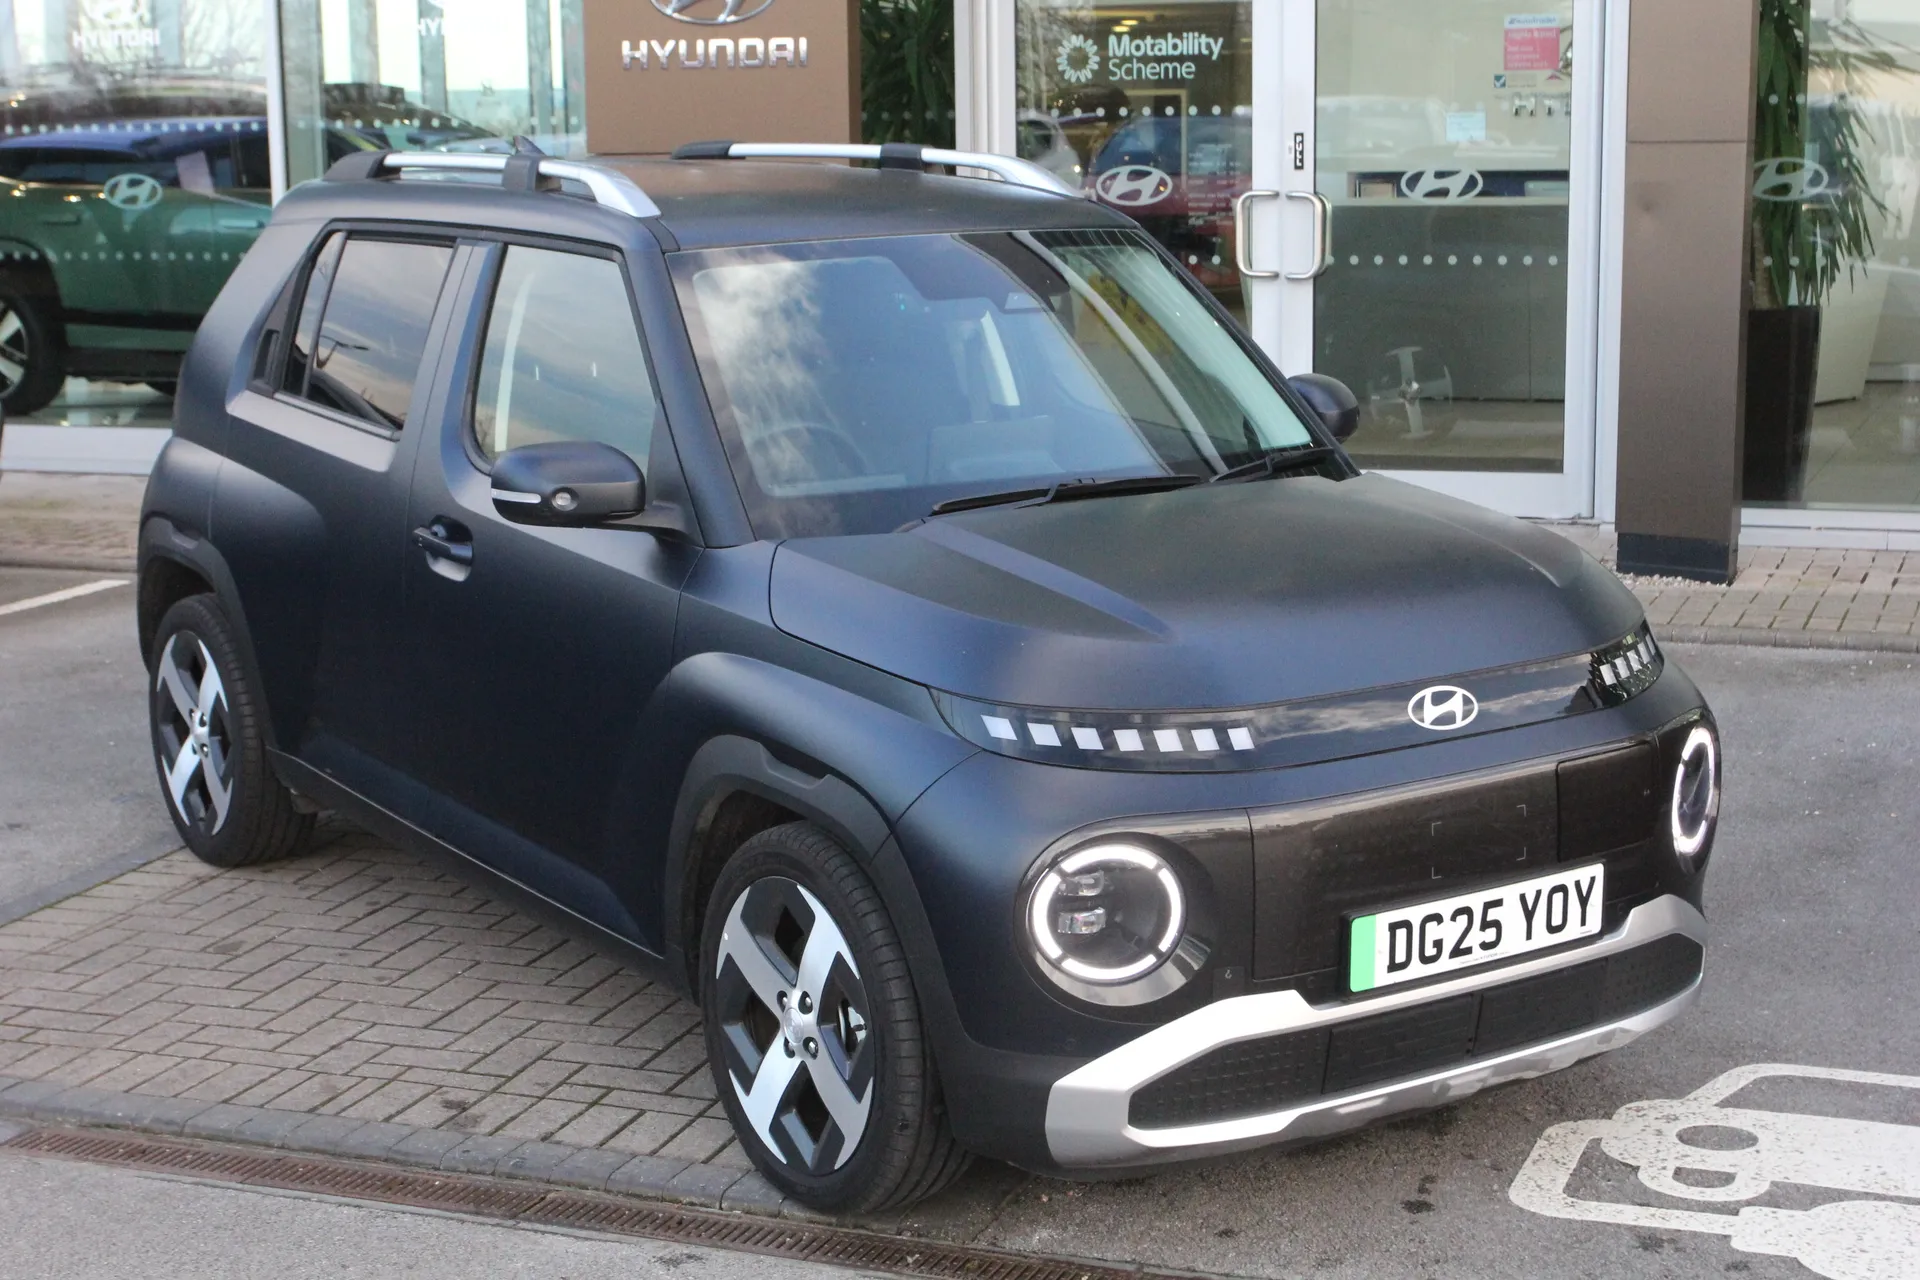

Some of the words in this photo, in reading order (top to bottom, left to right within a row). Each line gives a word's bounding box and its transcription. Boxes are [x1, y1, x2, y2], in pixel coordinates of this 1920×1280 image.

[621, 37, 808, 70] HYUNDAI
[1108, 32, 1224, 60] Motability
[1108, 58, 1196, 80] Scheme
[1295, 135, 1303, 167] PULL
[1387, 898, 1504, 974] DG25
[1519, 875, 1597, 941] YOY
